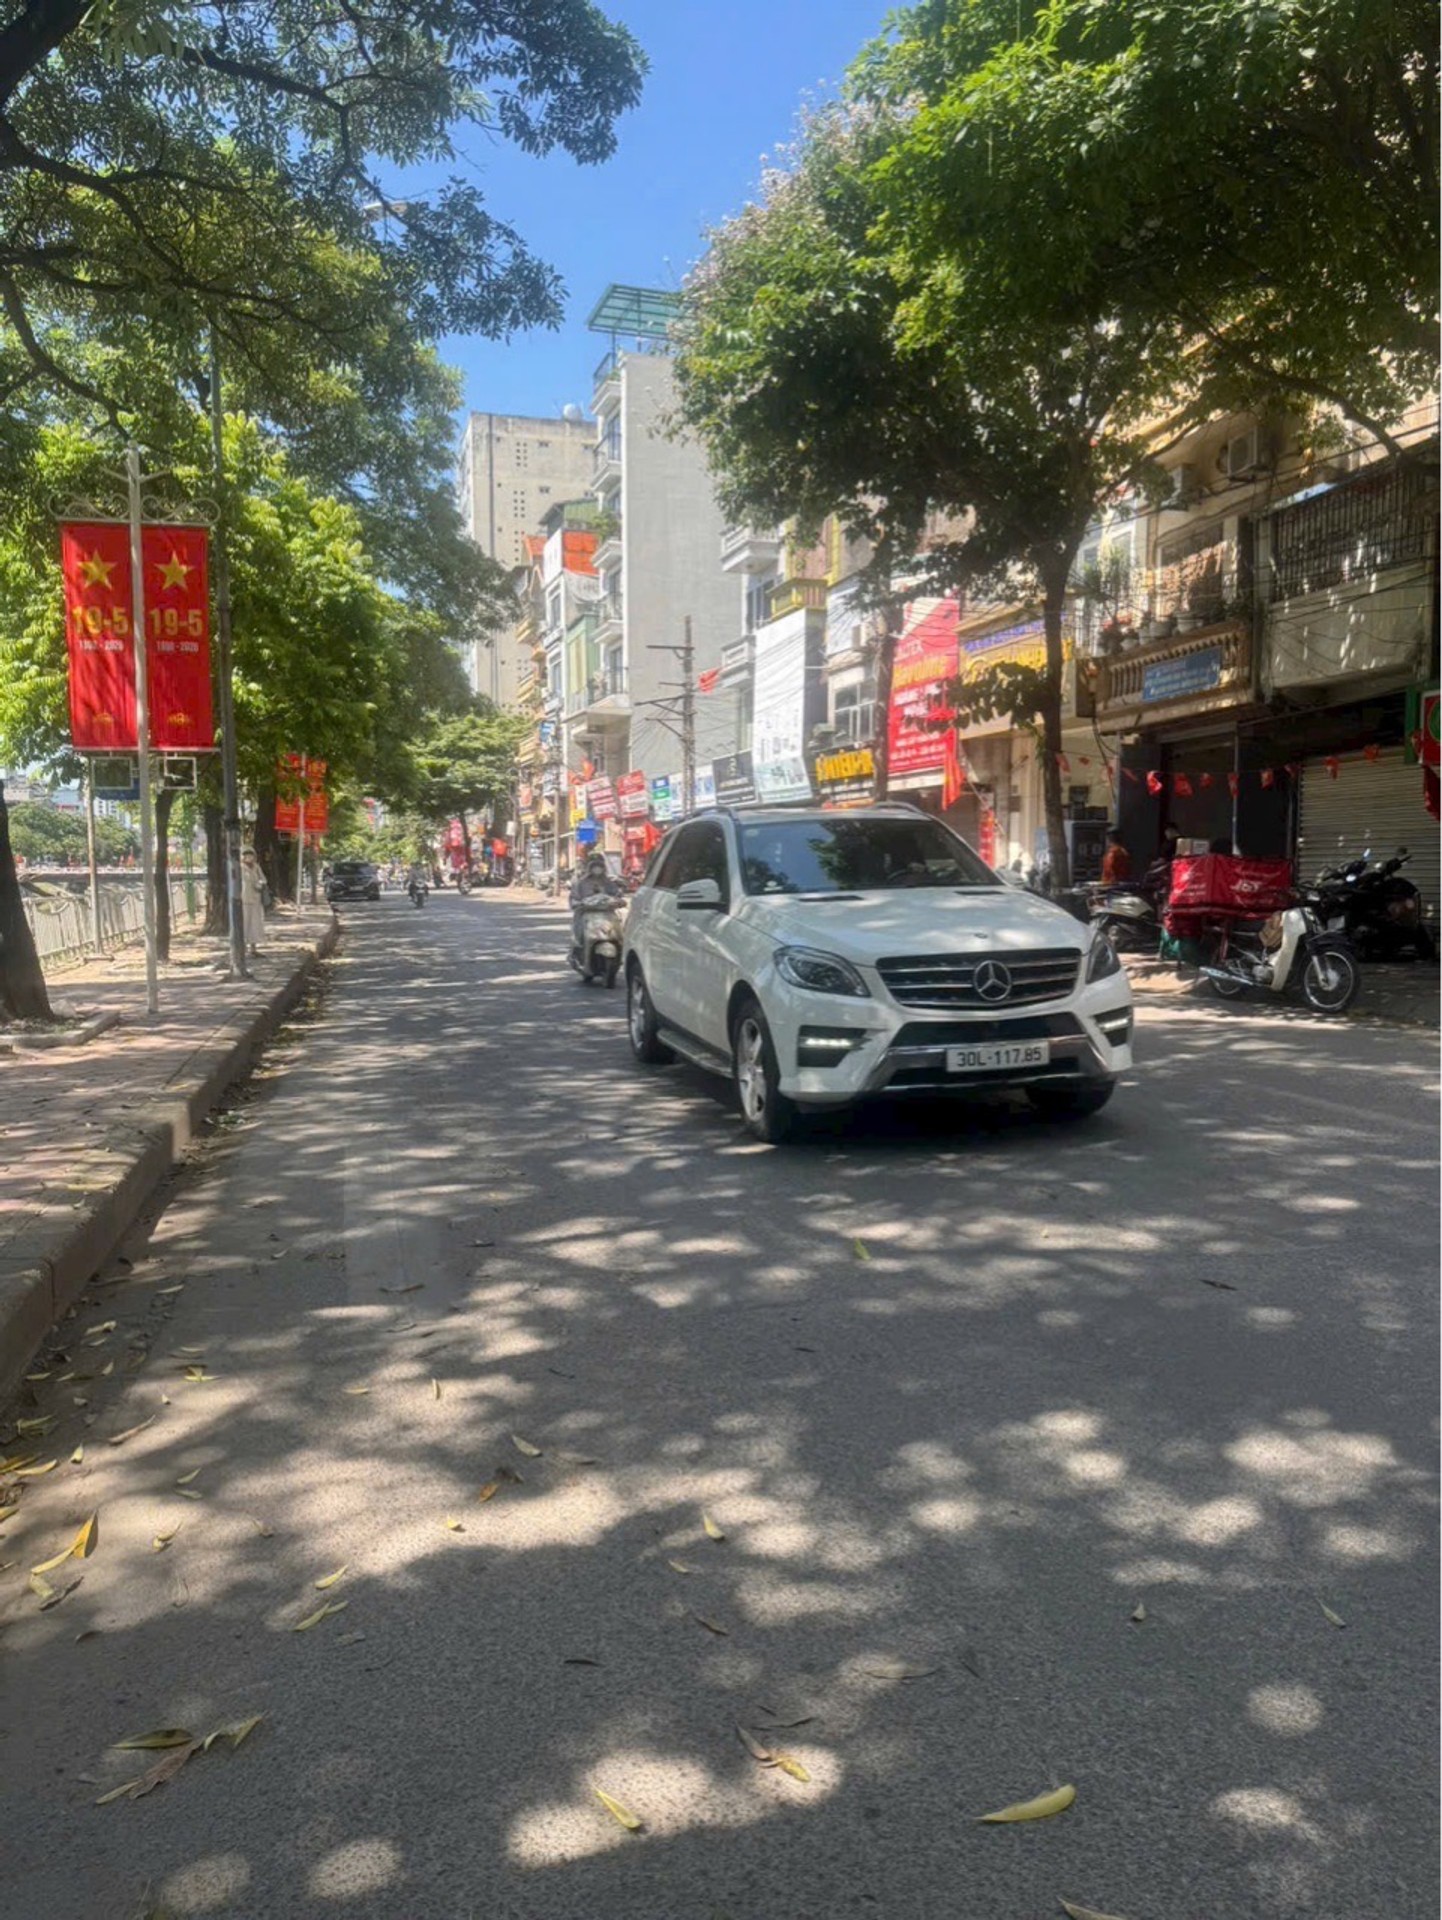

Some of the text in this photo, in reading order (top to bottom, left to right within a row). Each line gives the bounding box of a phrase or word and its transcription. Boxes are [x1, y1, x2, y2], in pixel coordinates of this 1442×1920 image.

[72, 605, 129, 635] 19-5
[149, 607, 203, 636] 19-5
[956, 1047, 1042, 1067] 30L-117.85
